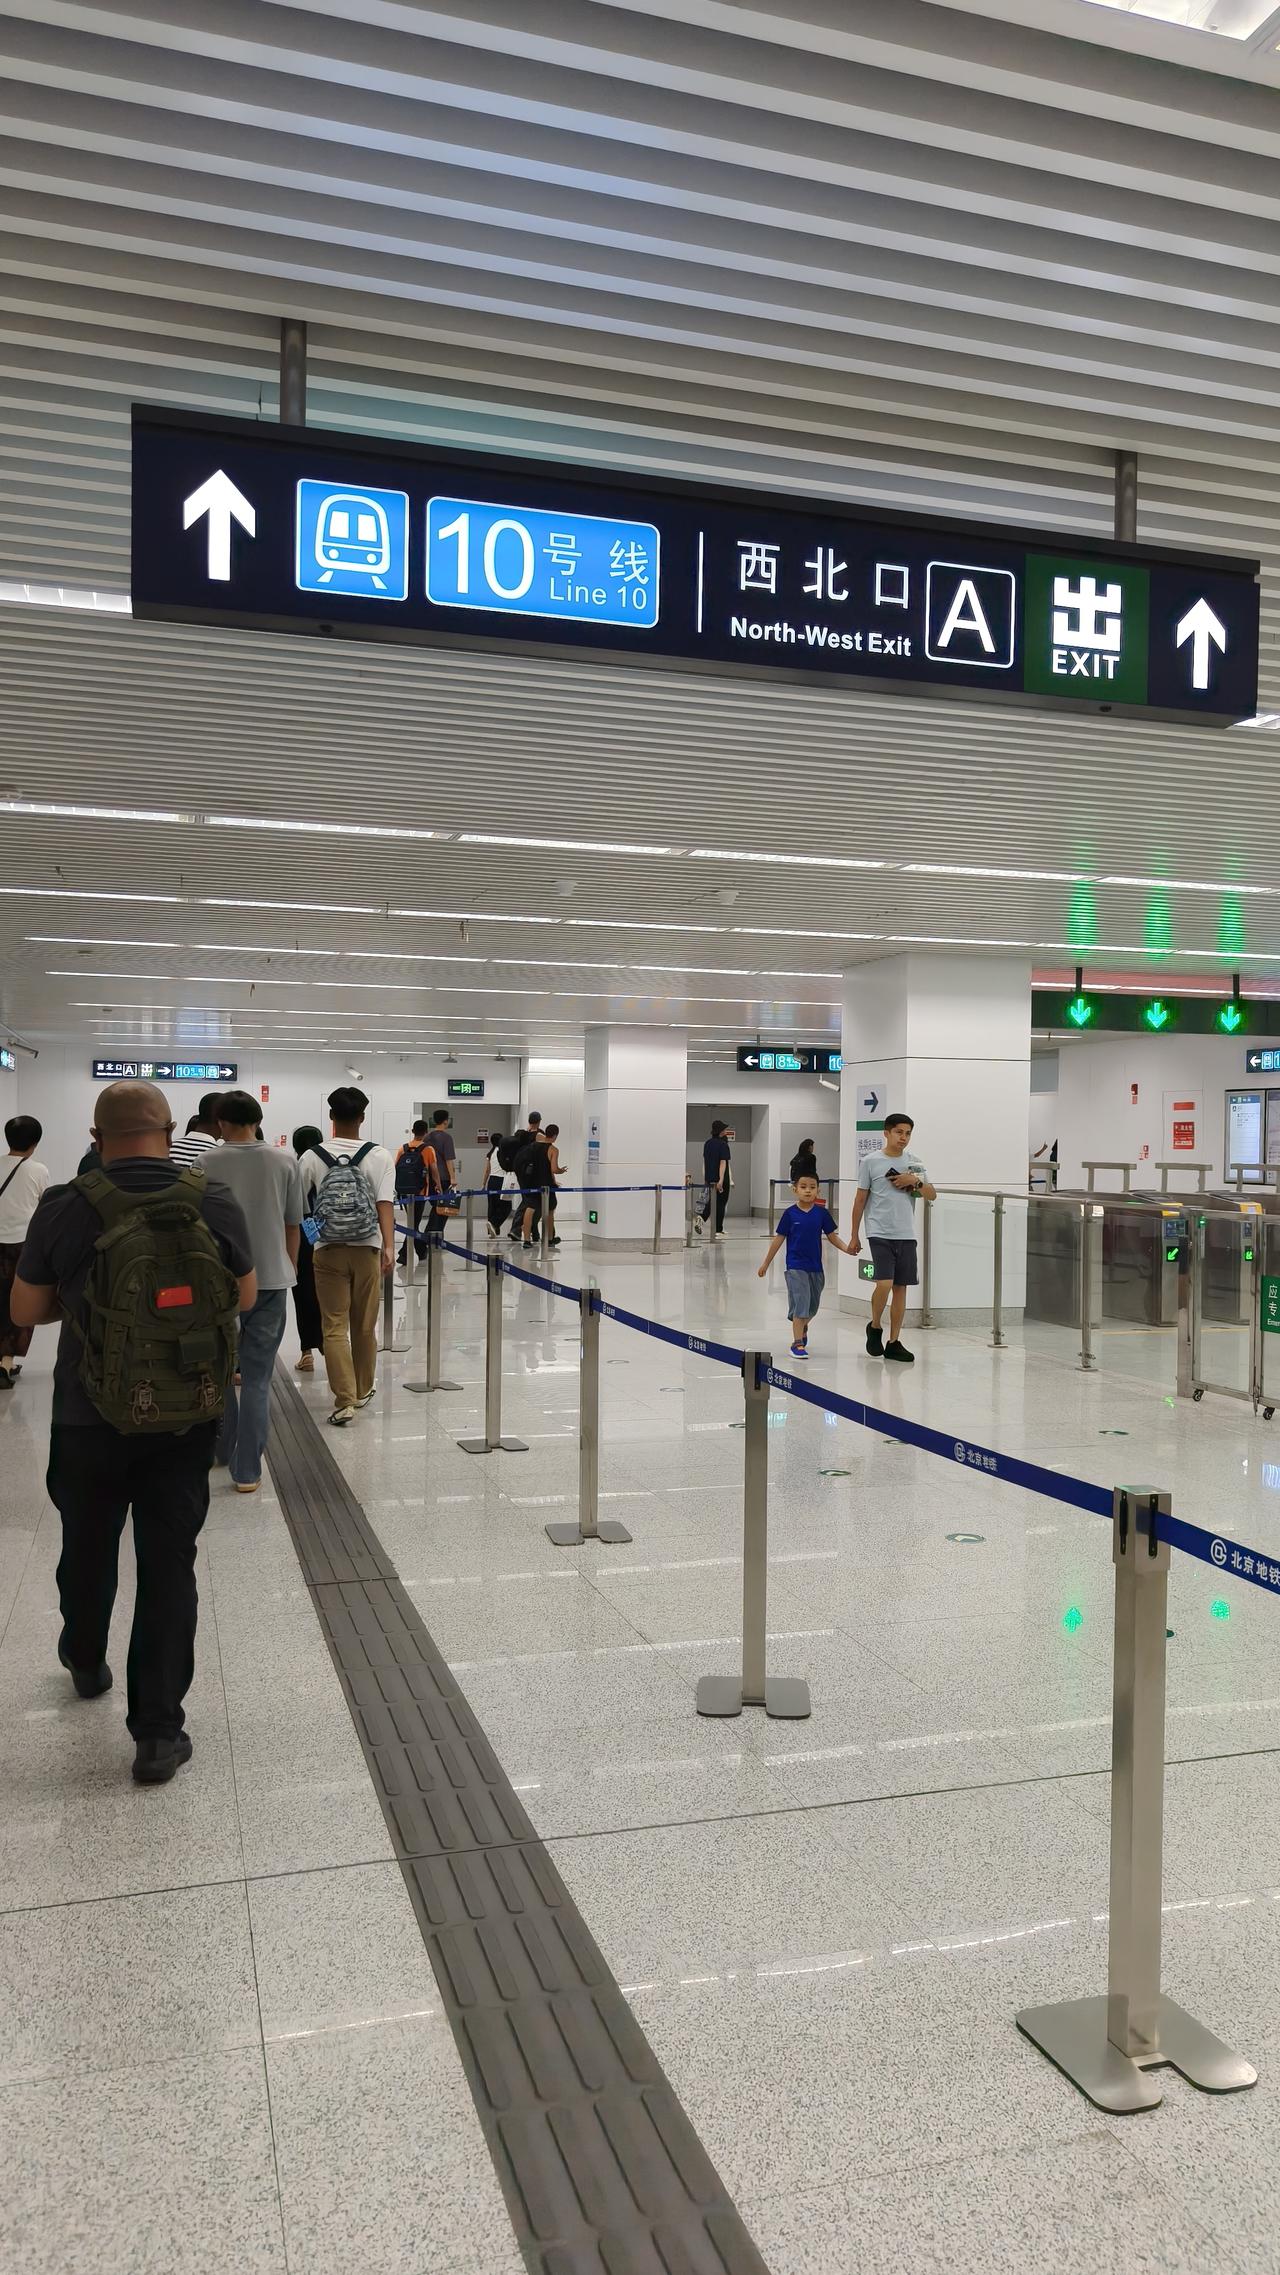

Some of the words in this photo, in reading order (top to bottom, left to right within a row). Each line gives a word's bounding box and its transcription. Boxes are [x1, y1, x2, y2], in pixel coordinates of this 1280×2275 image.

[549, 577, 607, 605] Line
[616, 587, 648, 611] 10
[737, 540, 910, 610] 西北口
[936, 579, 996, 654] A
[1052, 576, 1122, 651] 出
[730, 616, 863, 653] North-West
[867, 632, 912, 658] Exit
[1051, 649, 1121, 680] EXIT
[966, 1449, 999, 1472] 北京地铁
[1231, 1550, 1280, 1587] 北京地铁
